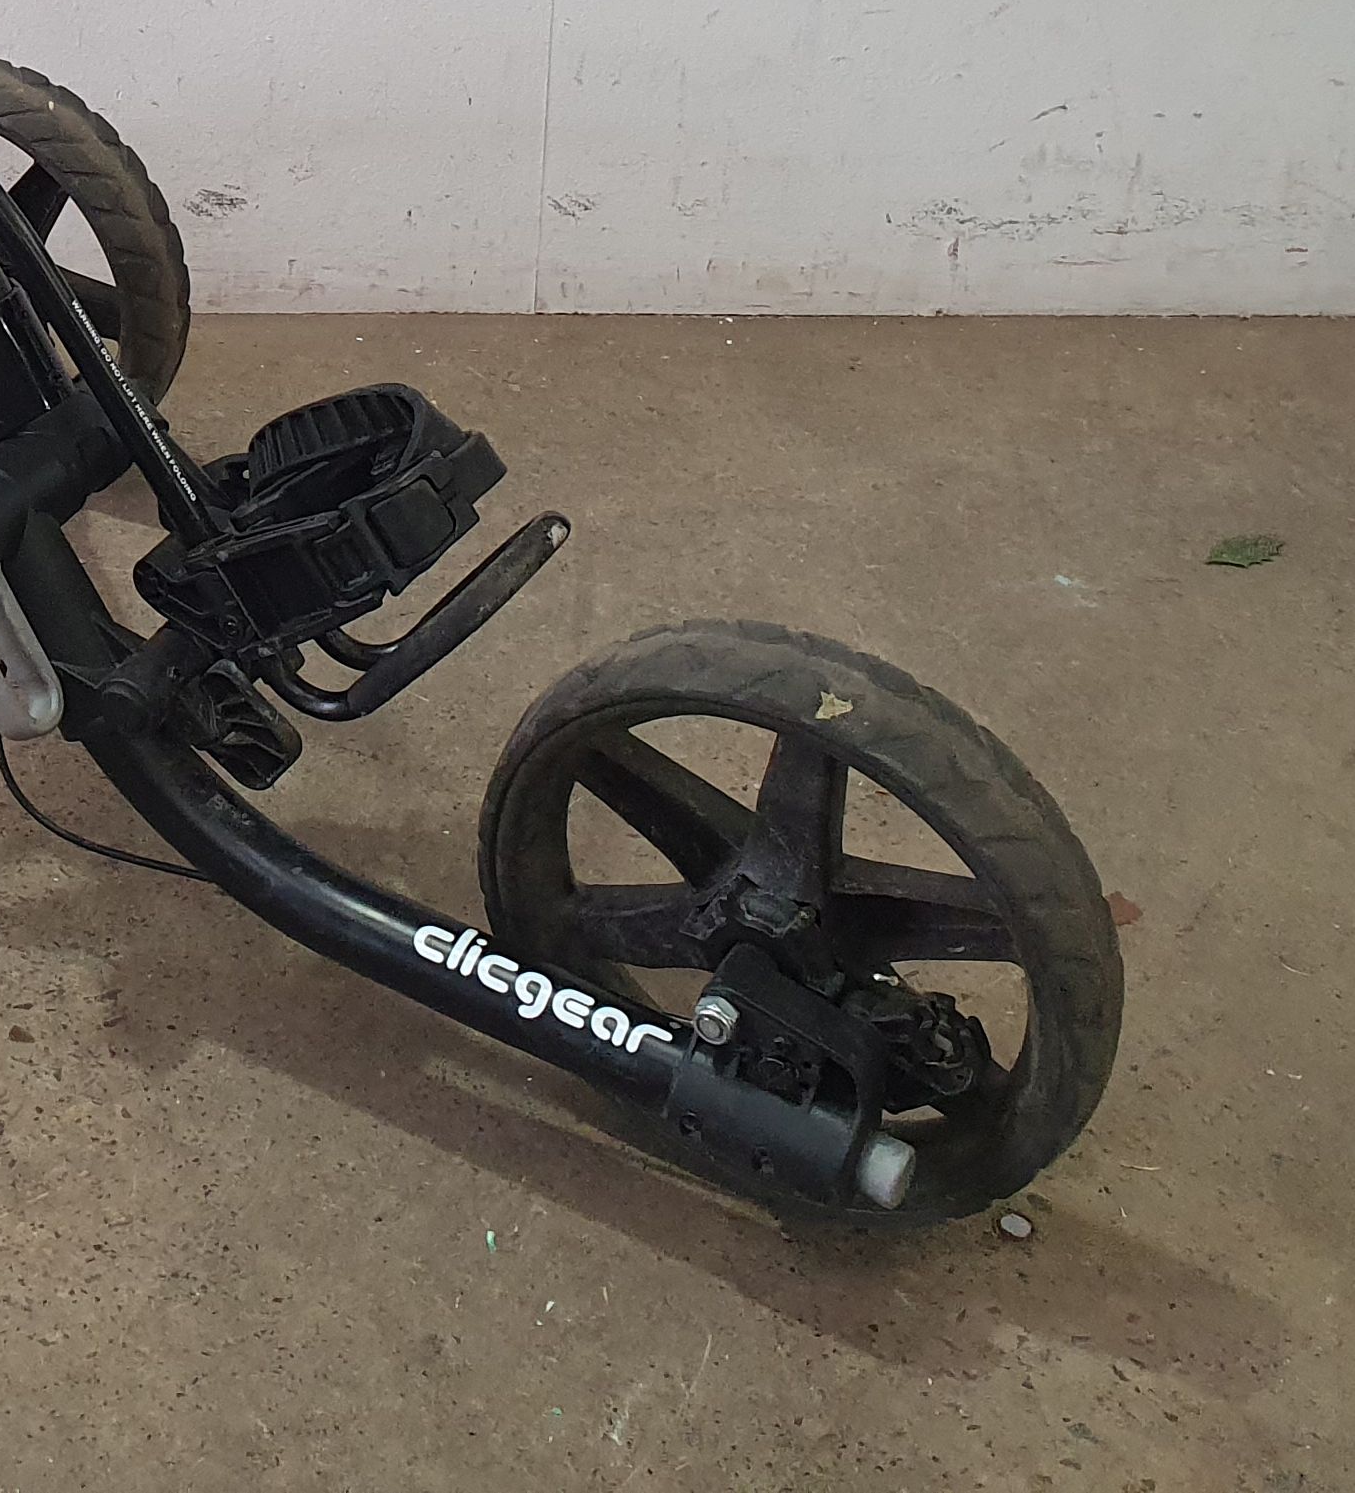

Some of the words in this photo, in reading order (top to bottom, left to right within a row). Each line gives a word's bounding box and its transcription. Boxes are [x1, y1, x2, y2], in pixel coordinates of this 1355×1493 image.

[100, 348, 112, 362] DO
[109, 363, 124, 379] NOT
[122, 383, 137, 402] LIFT
[135, 404, 153, 430] HERE
[151, 430, 171, 459] WHEN
[169, 459, 197, 501] FOLDING
[413, 925, 673, 1054] clicgear
